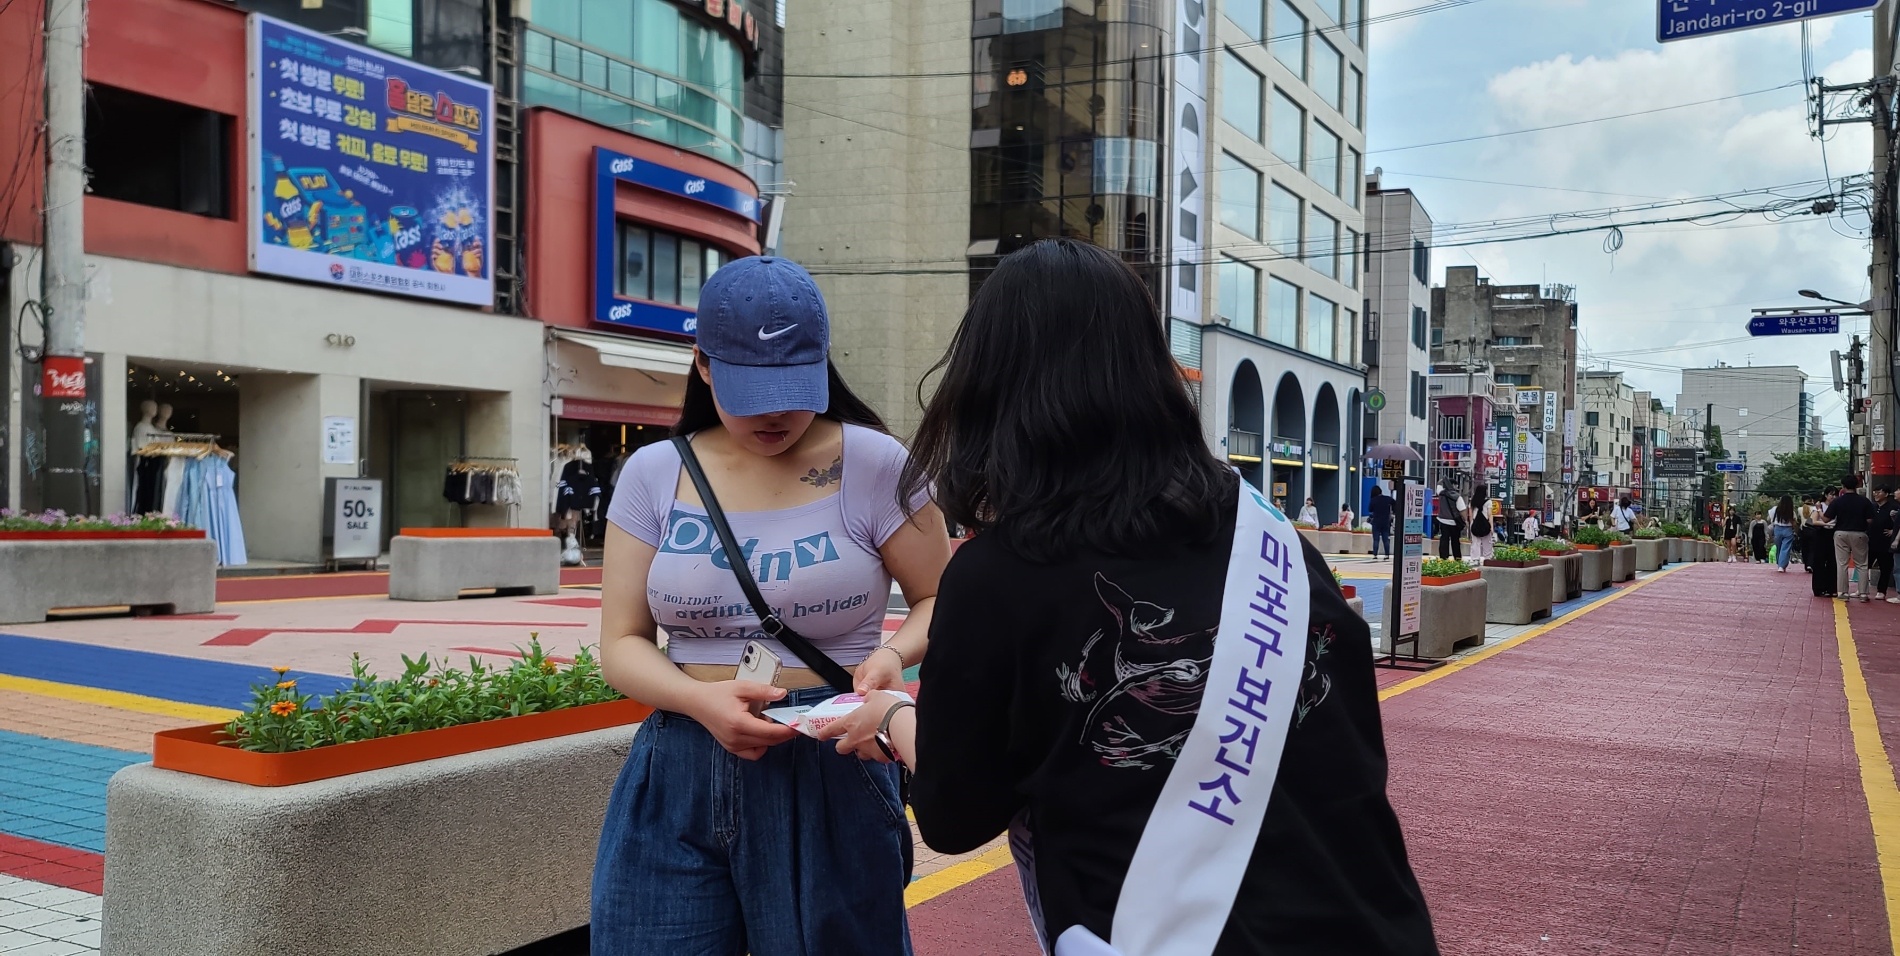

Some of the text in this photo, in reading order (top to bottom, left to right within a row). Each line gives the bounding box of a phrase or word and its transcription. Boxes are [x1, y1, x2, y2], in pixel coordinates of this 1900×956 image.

[1667, 0, 1817, 35] Jandari-ro 2-gil
[279, 57, 298, 82] 첫
[300, 63, 331, 92] 방문
[332, 74, 365, 101] 무료!
[280, 86, 377, 131] 초보 무료 강습!
[279, 118, 298, 142] 첫
[300, 123, 331, 150] 방문
[400, 149, 428, 173] 무료!
[610, 158, 633, 174] Cass
[301, 173, 328, 190] PLAY
[684, 180, 705, 194] Cass
[609, 303, 632, 320] Cass
[1778, 316, 1838, 327] 와우산로19길
[1818, 326, 1838, 334] 19-gil
[1545, 392, 1554, 424] 교복대여
[343, 500, 374, 518] 50%
[347, 521, 369, 531] SALE
[792, 591, 870, 619] holiday
[1187, 529, 1293, 827] 마포구보건소
